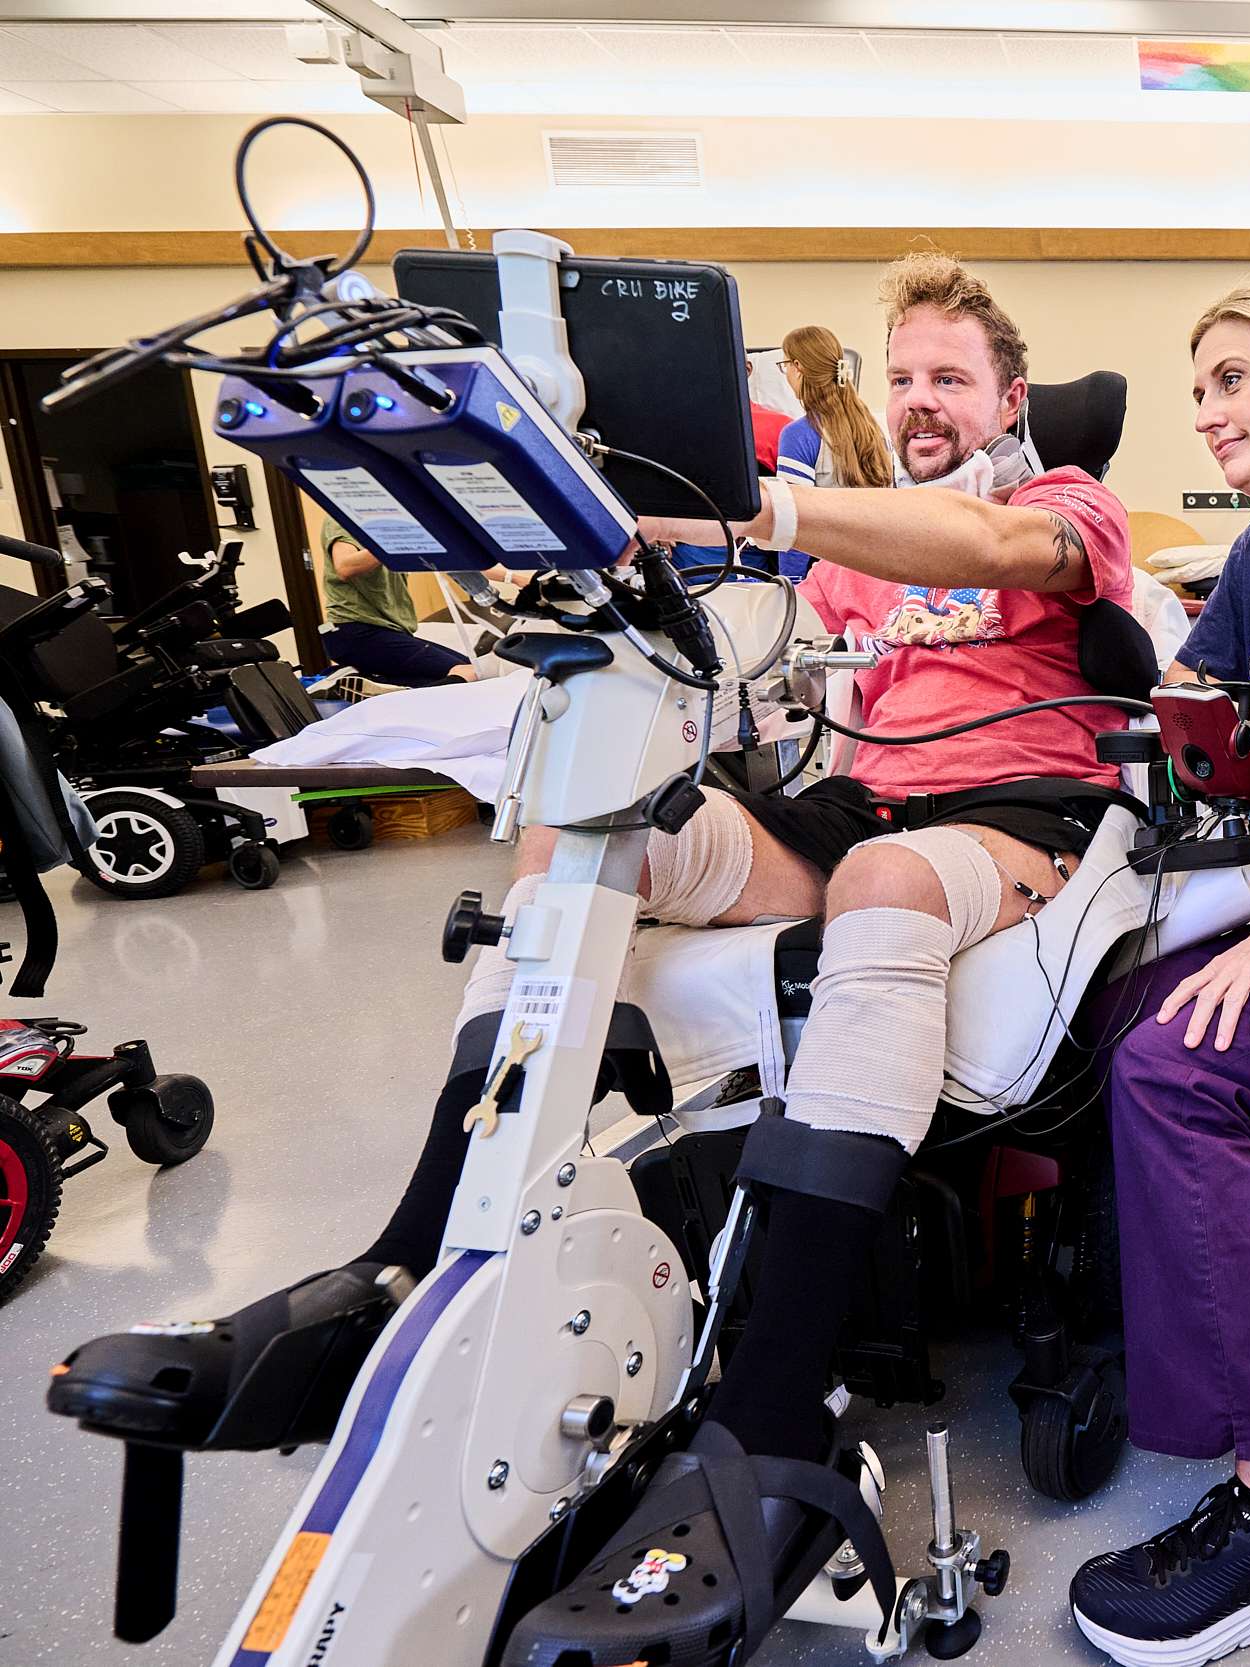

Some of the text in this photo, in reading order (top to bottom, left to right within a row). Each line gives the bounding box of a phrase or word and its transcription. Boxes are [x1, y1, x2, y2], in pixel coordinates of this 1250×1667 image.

[601, 279, 700, 300] CRU BIKE
[671, 301, 690, 322] 2
